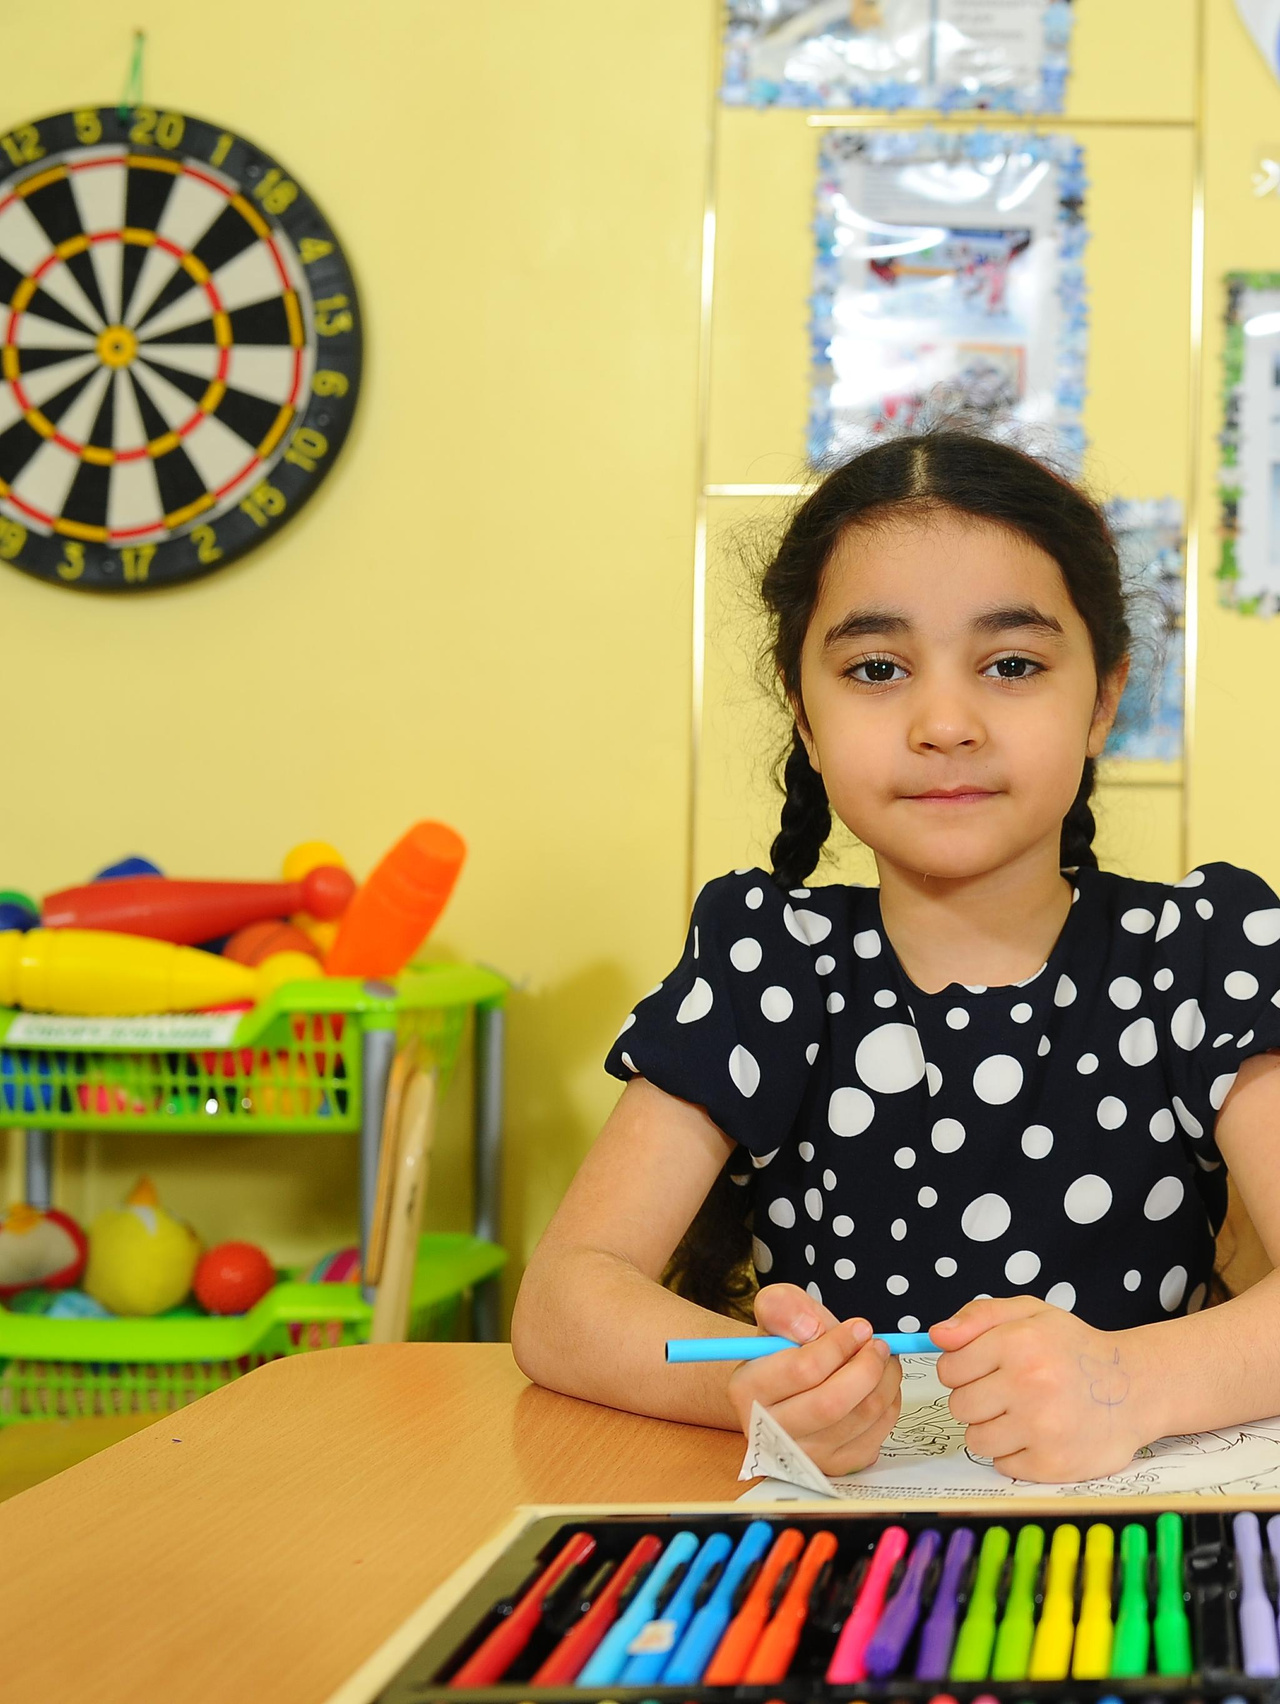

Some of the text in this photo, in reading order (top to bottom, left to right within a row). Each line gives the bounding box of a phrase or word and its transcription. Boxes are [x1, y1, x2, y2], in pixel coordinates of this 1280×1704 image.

[1, 124, 45, 166] 12
[73, 107, 102, 144] 5
[130, 108, 184, 149] 20
[210, 133, 233, 167] 1
[254, 168, 297, 215] 18
[300, 238, 332, 264] 4
[284, 427, 328, 472] 10
[240, 479, 286, 527] 15
[57, 540, 84, 581] 3
[120, 543, 156, 583] 17
[190, 524, 223, 564] 2
